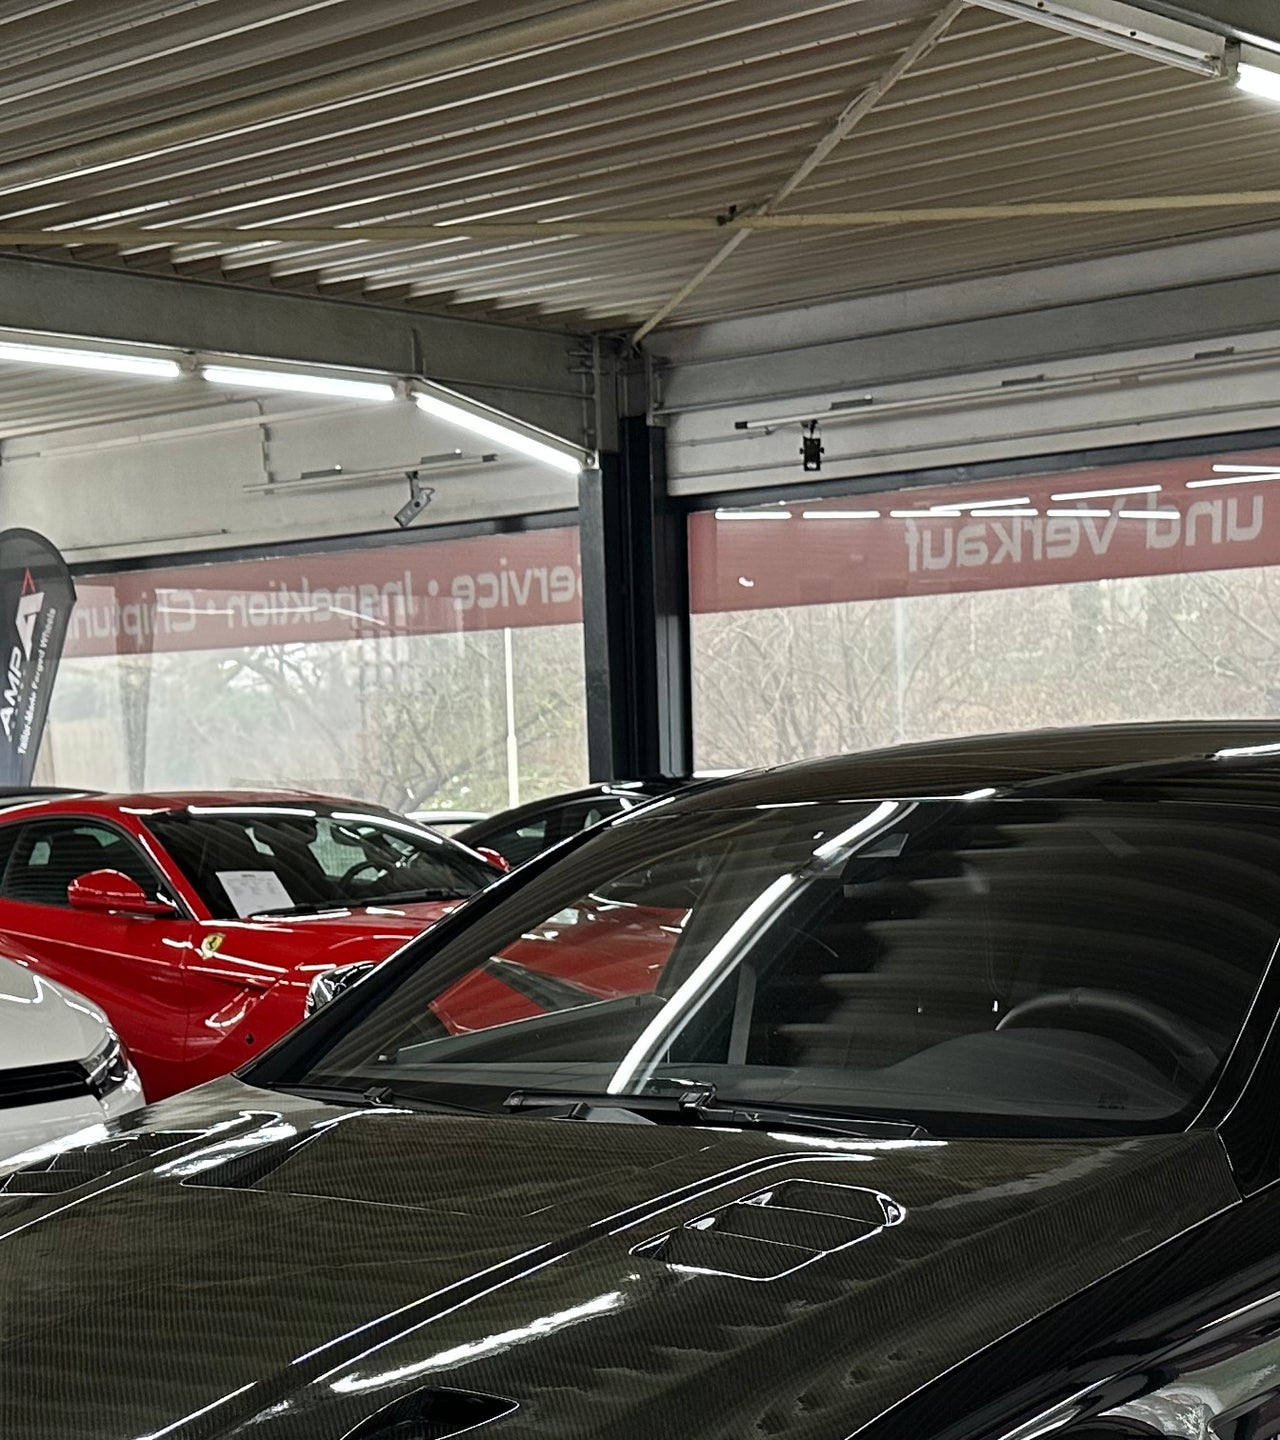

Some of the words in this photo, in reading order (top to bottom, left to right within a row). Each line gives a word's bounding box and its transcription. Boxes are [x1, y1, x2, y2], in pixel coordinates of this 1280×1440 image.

[0, 645, 23, 737] AMP
[17, 692, 37, 755] Tailor-Made
[39, 607, 57, 649] Wheels
